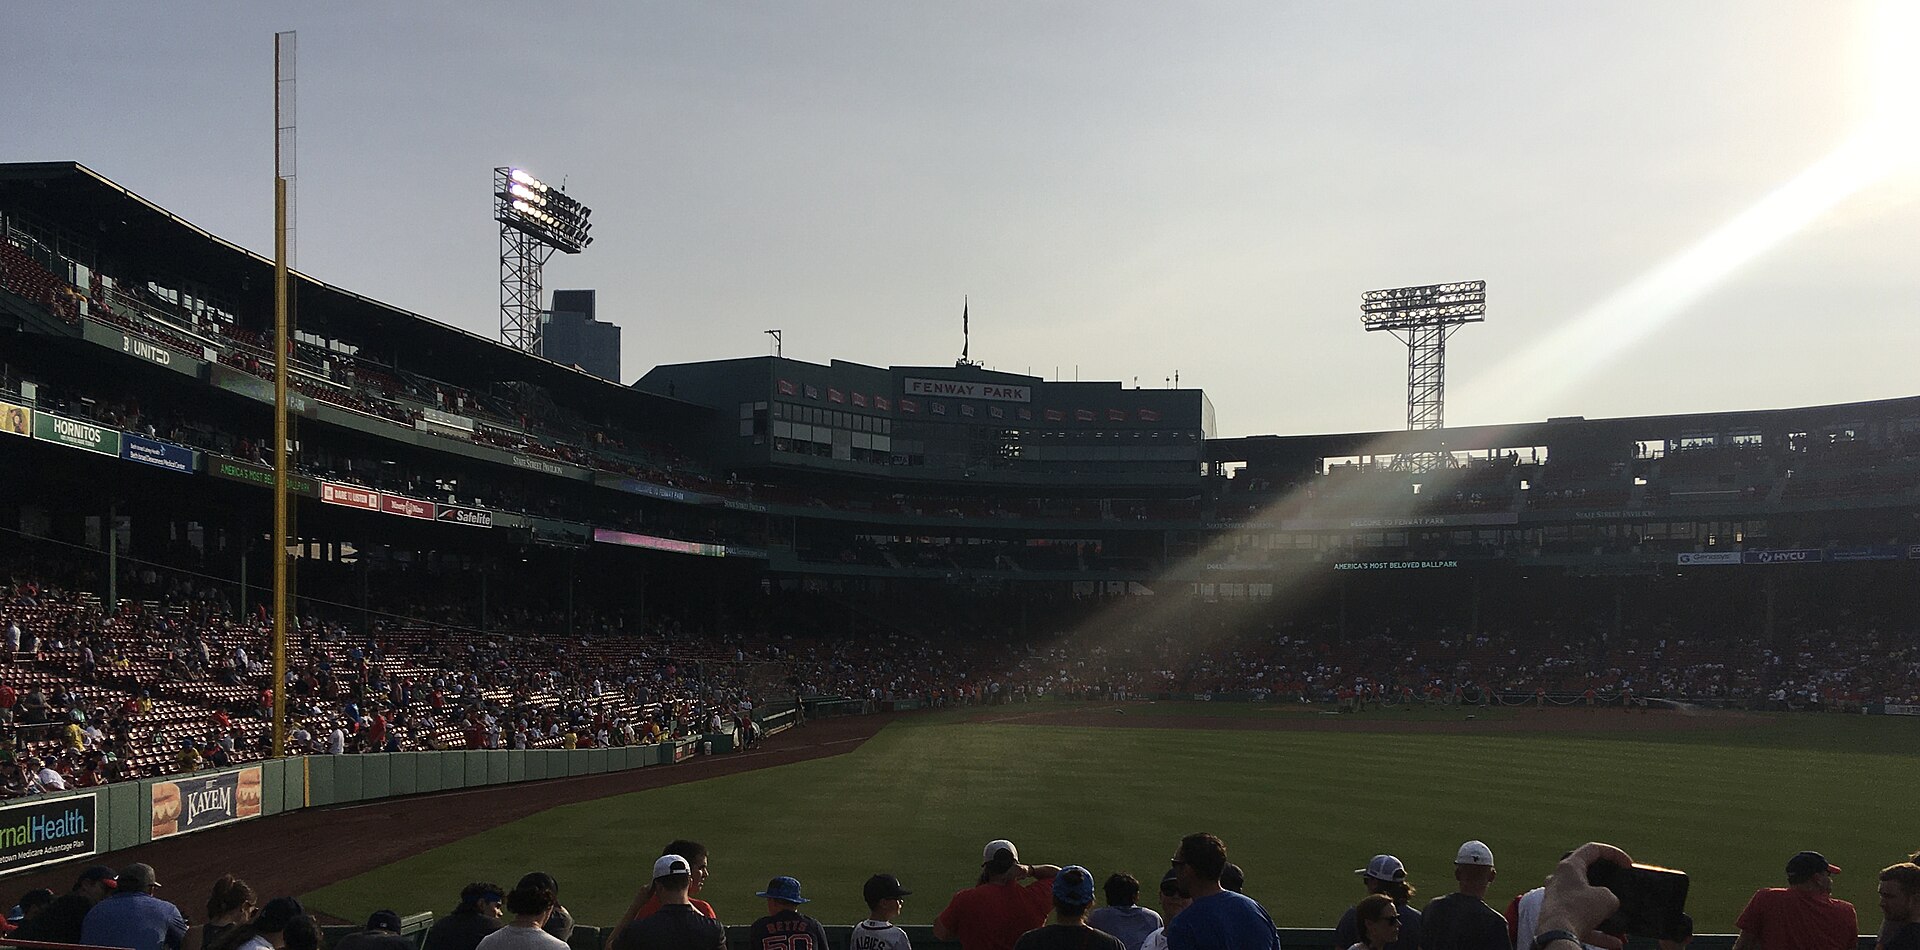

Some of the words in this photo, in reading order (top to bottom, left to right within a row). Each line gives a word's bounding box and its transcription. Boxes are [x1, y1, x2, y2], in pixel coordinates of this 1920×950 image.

[134, 340, 170, 365] UNITED
[913, 382, 975, 396] FENWAY
[983, 387, 1023, 399] PARK
[54, 419, 101, 443] HORNITOS
[220, 464, 248, 479] AMERICA'S
[456, 511, 491, 525] Safelite
[1394, 518, 1423, 526] FENWAY
[1425, 517, 1445, 525] PARK
[1774, 551, 1806, 560] HYCU
[1333, 562, 1368, 570] AMERICA'S
[1369, 562, 1388, 570] MOST
[1421, 561, 1458, 569] BALLPARK
[186, 787, 231, 825] KAYEM
[18, 849, 43, 860] Medicare
[44, 842, 72, 855] Advantage
[72, 840, 84, 849] Plan
[766, 920, 808, 934] BETTS
[856, 936, 886, 950] ALBIES
